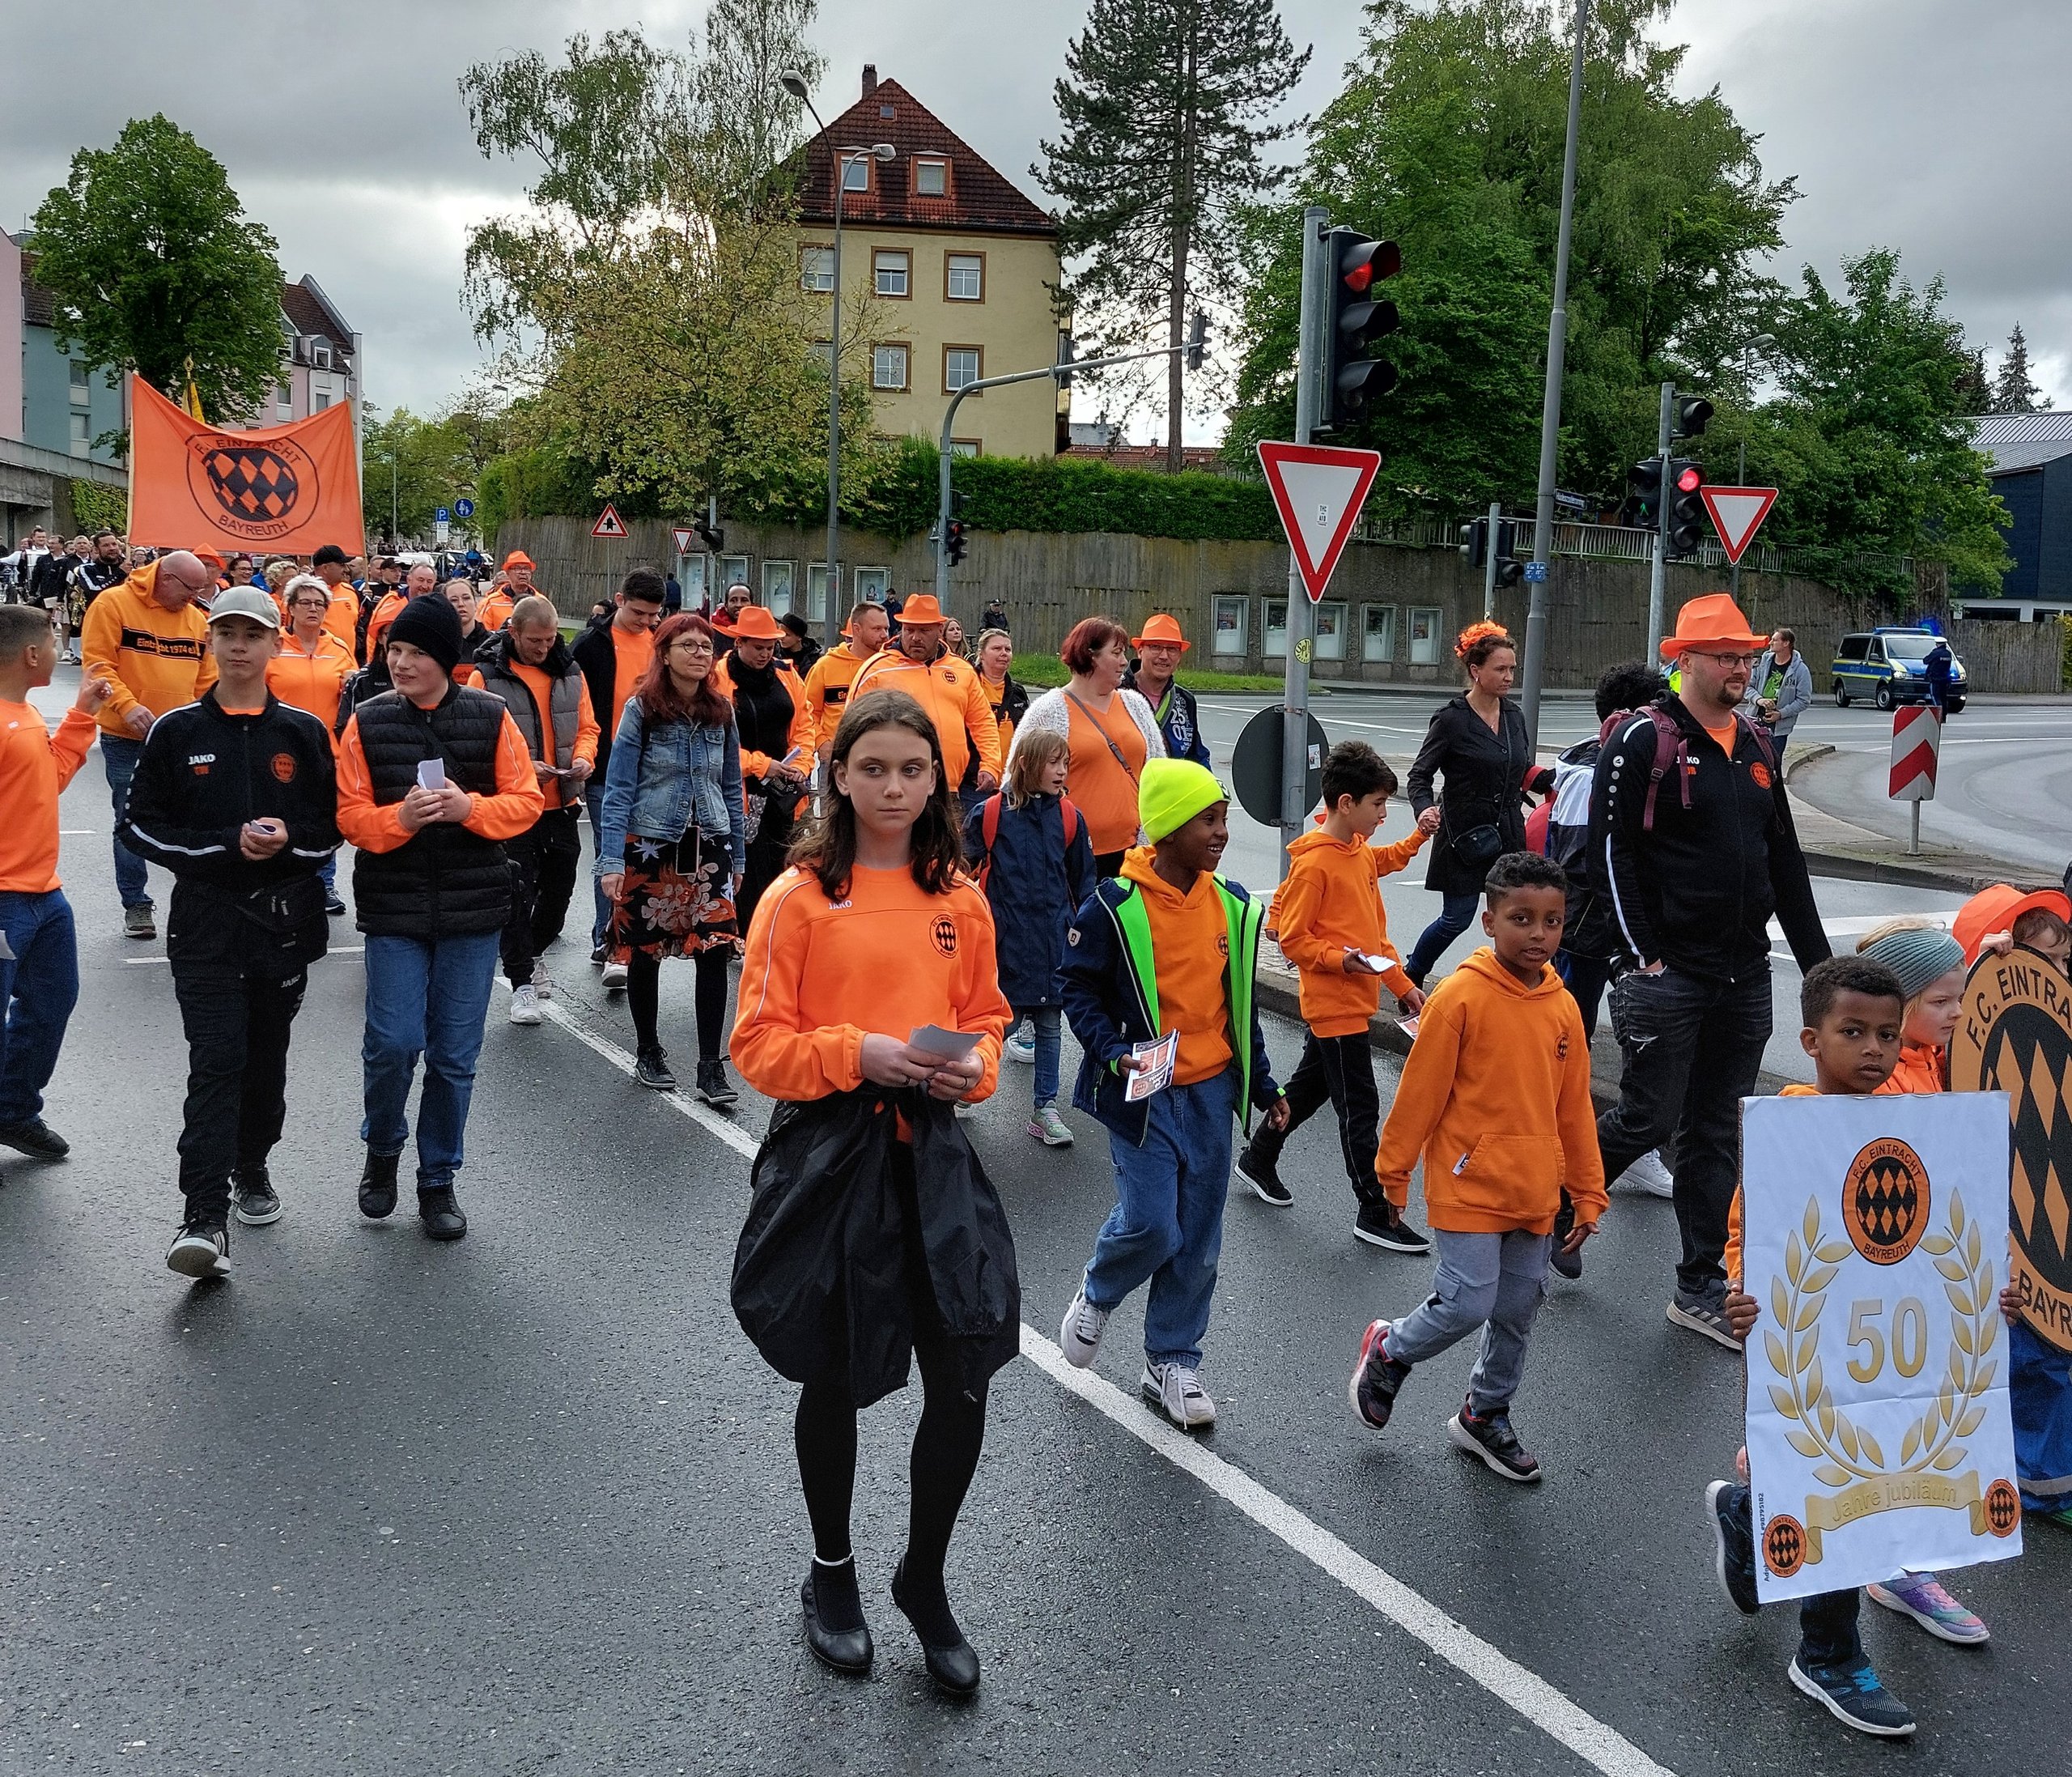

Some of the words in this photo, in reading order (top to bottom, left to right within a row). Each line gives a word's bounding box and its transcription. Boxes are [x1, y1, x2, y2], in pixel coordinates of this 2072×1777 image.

[439, 509, 446, 520] P
[219, 515, 289, 536] BAYREUTH
[170, 644, 187, 654] 1974
[1170, 708, 1186, 725] 25
[188, 754, 216, 765] JAKO
[1676, 755, 1700, 765] JKO
[828, 899, 853, 910] JAKO
[1966, 992, 1998, 1052] F.C.
[1996, 964, 2072, 1030] EINTRA
[1853, 1159, 1869, 1180] F.C.
[1869, 1143, 1921, 1177] EINTRACHT
[1863, 1240, 1911, 1260] BAYREUTH
[2019, 1268, 2072, 1338] BAYR
[1846, 1297, 1927, 1384] 50
[1832, 1490, 1881, 1522] Jahre
[1885, 1479, 1957, 1508] jubiläum
